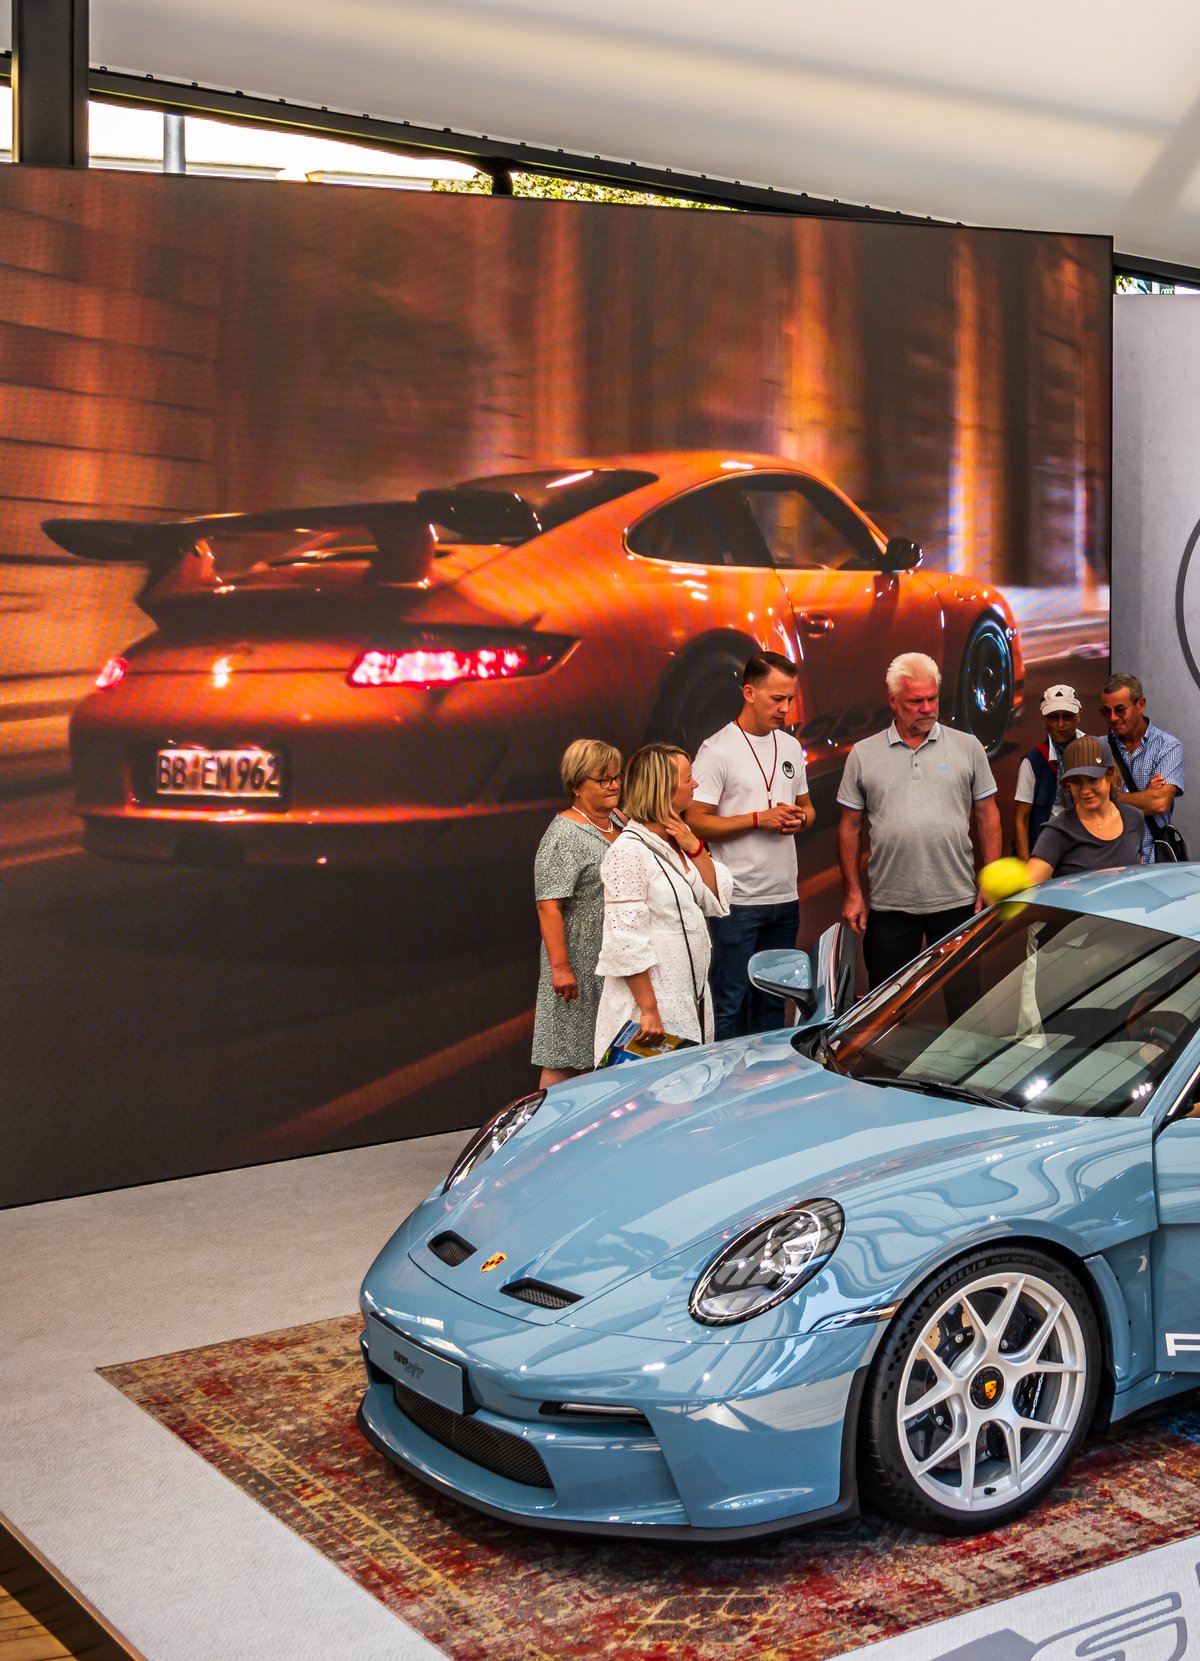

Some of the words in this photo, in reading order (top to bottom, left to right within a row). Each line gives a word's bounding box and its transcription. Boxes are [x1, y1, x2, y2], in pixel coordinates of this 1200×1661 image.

[158, 755, 187, 789] BB
[237, 756, 282, 791] 962
[928, 1260, 986, 1305] MICHELIN
